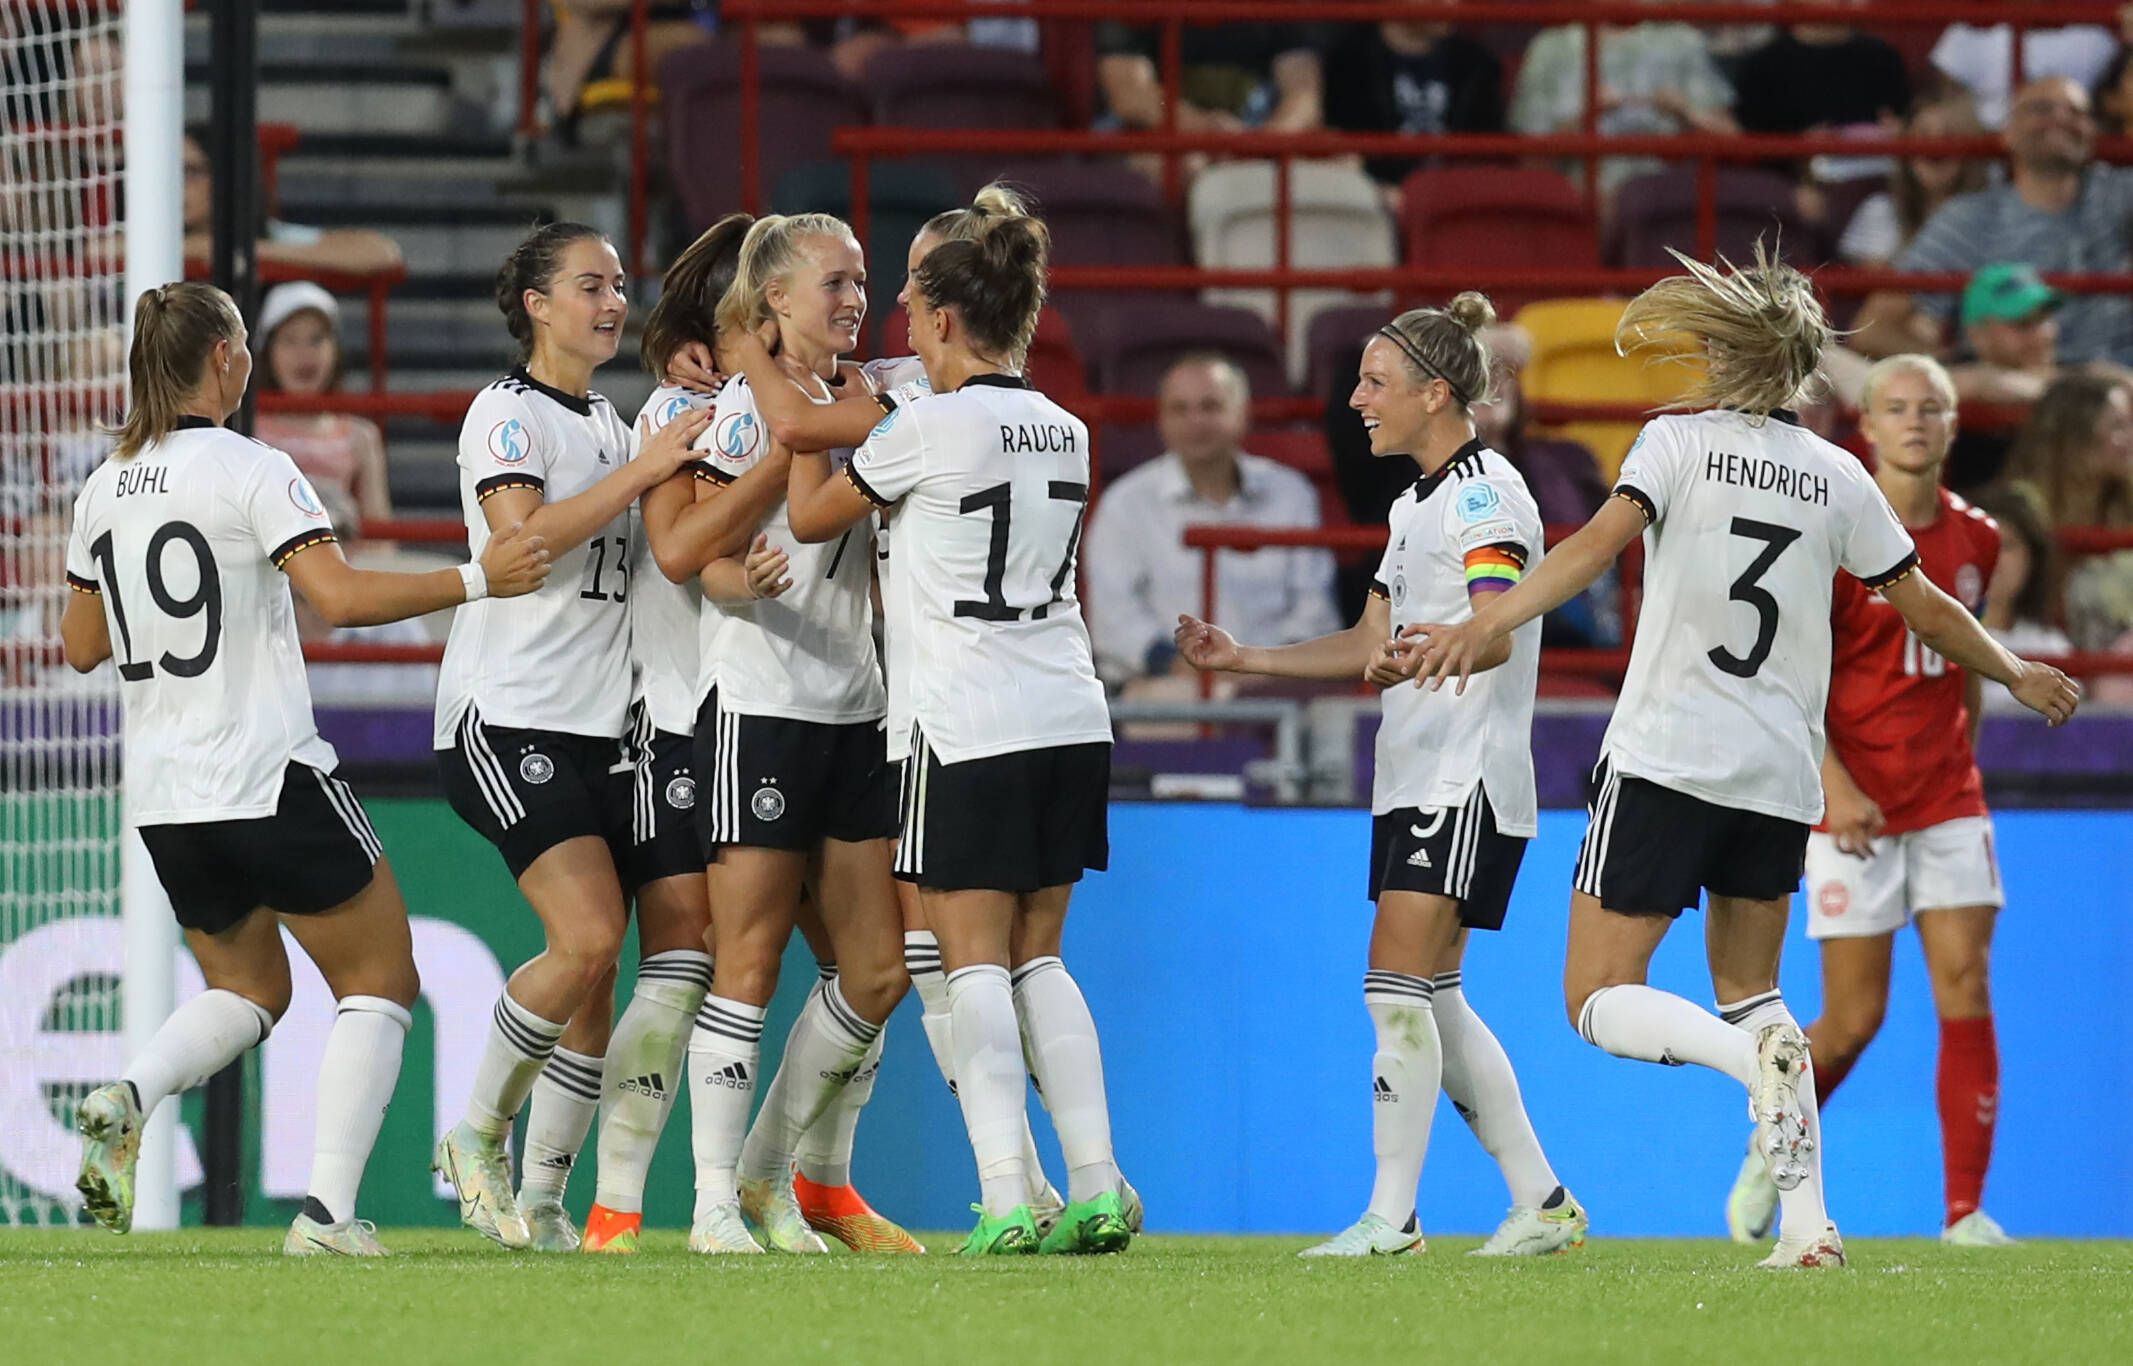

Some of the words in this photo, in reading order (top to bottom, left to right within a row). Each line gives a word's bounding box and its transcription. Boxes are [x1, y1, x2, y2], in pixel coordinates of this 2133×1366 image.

[1000, 424, 1076, 454] RAUCH
[116, 461, 169, 498] BÜHL
[1706, 451, 1829, 508] HENDRICH
[580, 536, 629, 604] 13
[953, 481, 1088, 622] 17
[90, 520, 222, 682] 19
[1707, 516, 1802, 678] 3
[618, 1081, 669, 1102] adidas
[705, 1073, 754, 1092] adidas
